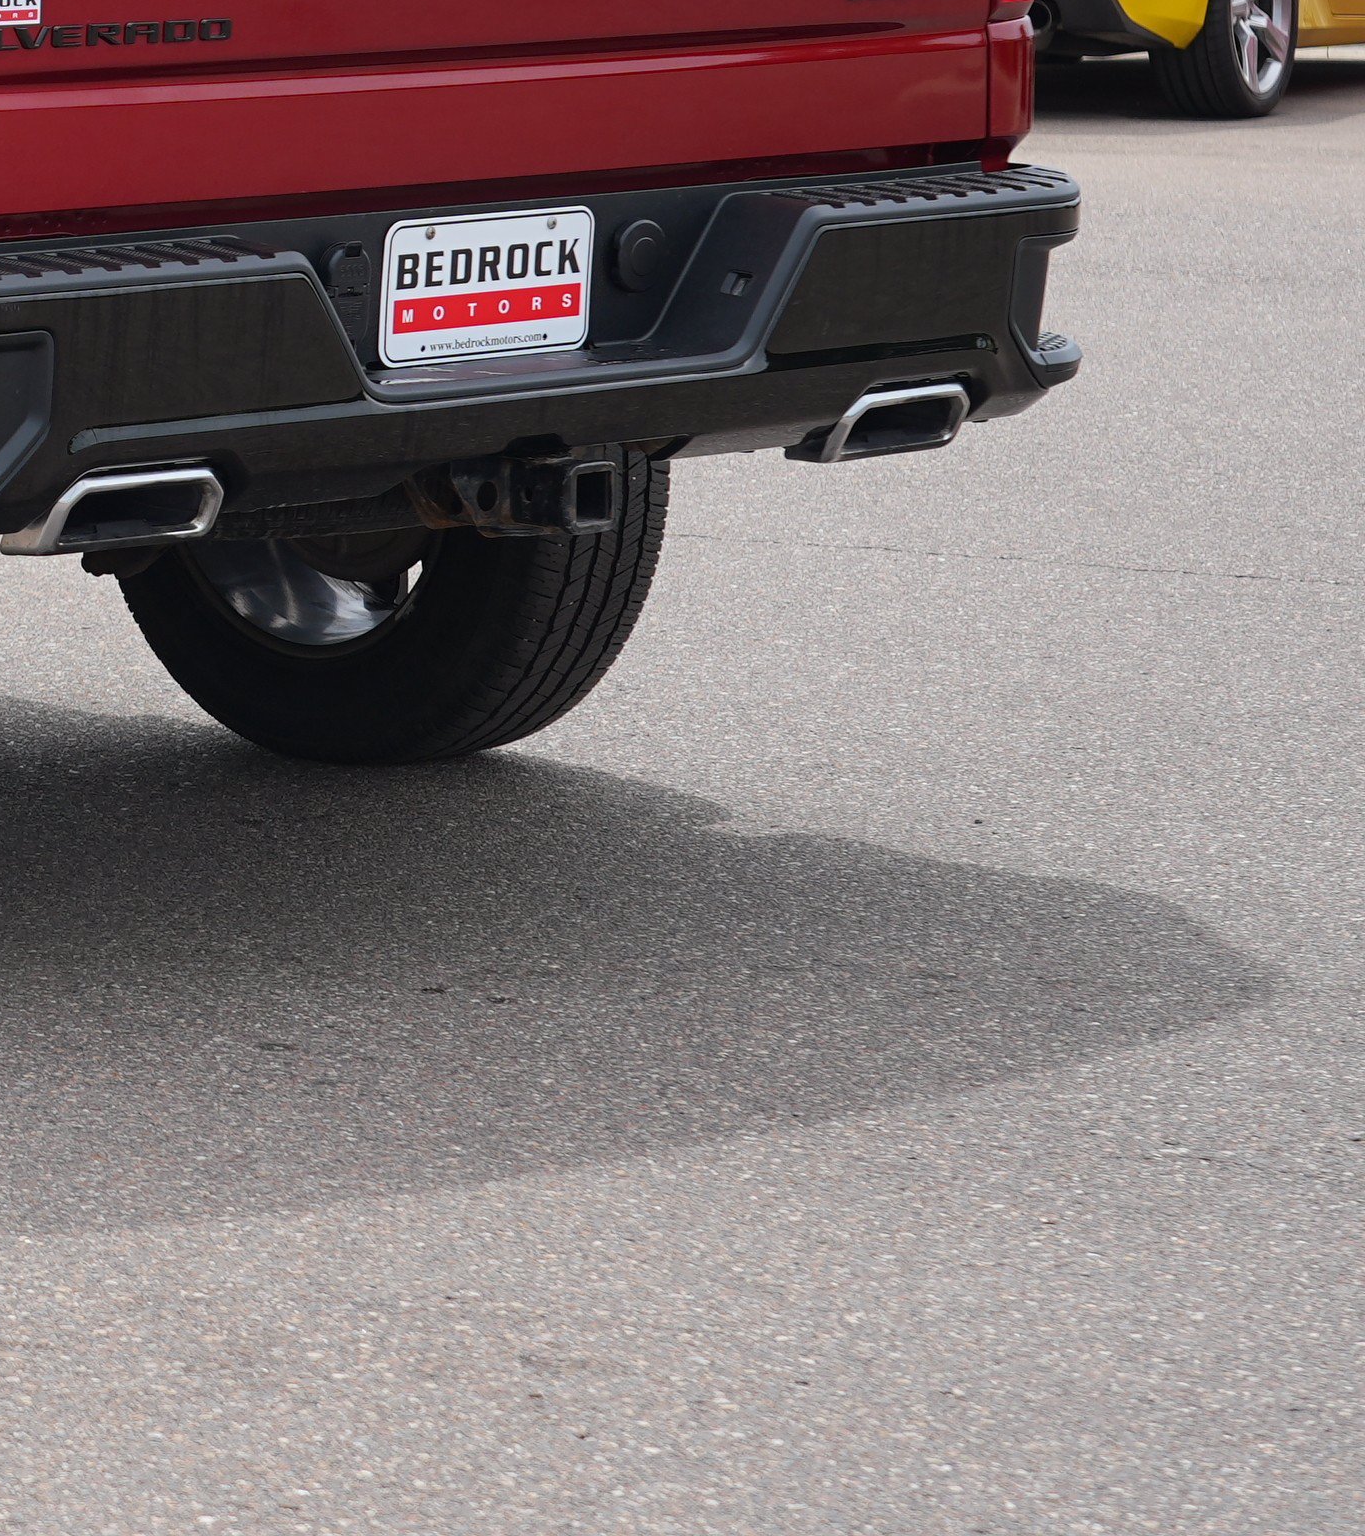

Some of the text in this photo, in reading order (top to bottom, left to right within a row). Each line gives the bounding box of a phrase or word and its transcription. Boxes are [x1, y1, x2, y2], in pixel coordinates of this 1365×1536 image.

[395, 238, 581, 290] BEDROCK
[401, 292, 573, 324] MOTORS
[429, 332, 543, 352] www.bedrockmotors.com
